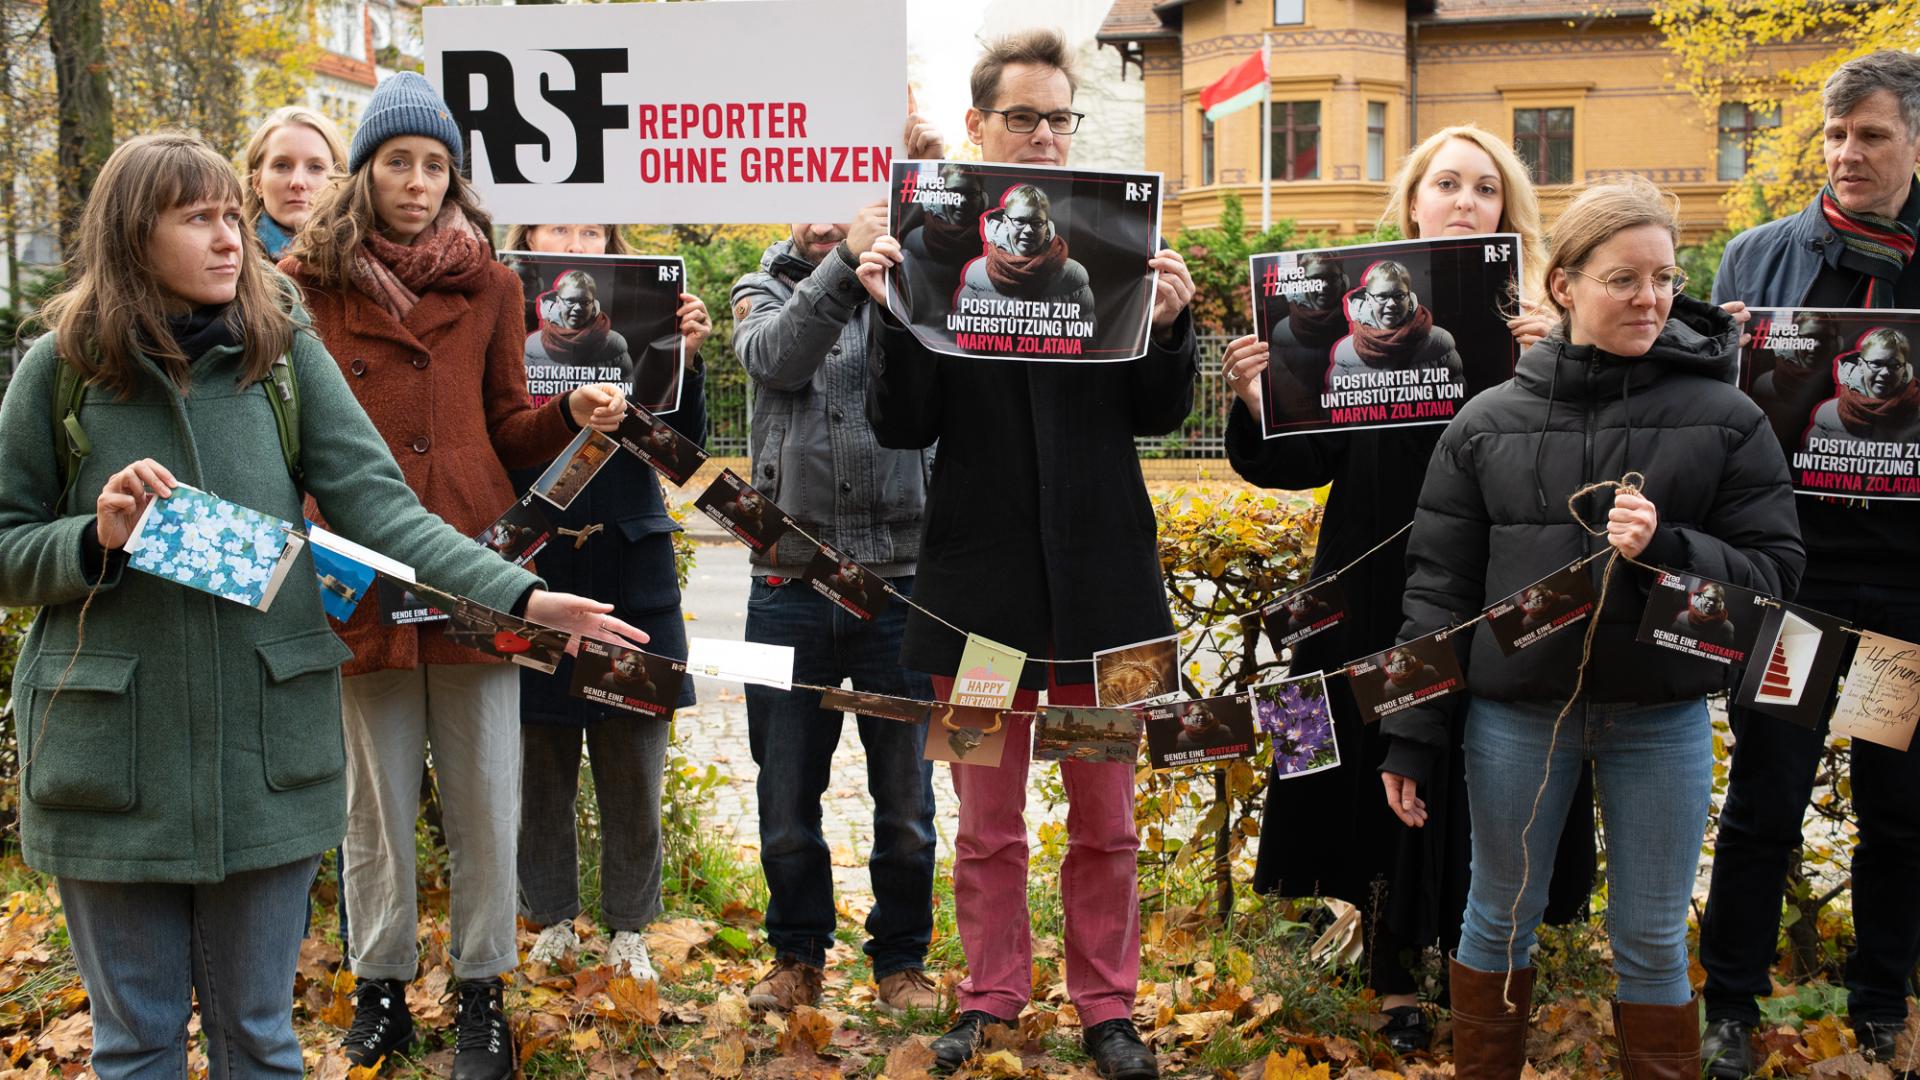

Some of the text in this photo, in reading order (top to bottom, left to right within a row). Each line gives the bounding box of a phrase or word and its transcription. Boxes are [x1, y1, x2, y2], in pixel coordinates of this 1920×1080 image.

[442, 48, 629, 184] RSF
[639, 102, 807, 140] REPORTER
[640, 146, 893, 184] OHNE GRENZEN
[911, 189, 961, 206] Zolatava
[1125, 182, 1152, 201] RSF
[1484, 243, 1511, 263] RSF
[658, 265, 680, 282] RSF
[1275, 278, 1323, 296] Zolatava
[960, 298, 1080, 319] POSTKARTEN ZUR
[946, 314, 1094, 337] UNTERSTÜTZUNG VON
[956, 332, 1082, 354] MARYNA ZOLATAVA
[1764, 335, 1815, 350] Zolatava
[598, 367, 622, 380] ZUR
[1333, 367, 1450, 390] POSTKARTEN ZUR
[1321, 383, 1464, 408] UNTERSTÜTZUNG VON
[1331, 400, 1454, 424] MARYNA ZOLATAVA
[1809, 437, 1920, 459] POSTKARTEN ZU
[1793, 452, 1914, 476] UNTERSTÜTZUNG
[1802, 471, 1920, 493] MARYNA ZOLATA
[1513, 631, 1536, 647] SENDE
[1653, 629, 1745, 660] SENDE EINE POSTKARTE
[583, 686, 608, 698] SENDE
[608, 692, 624, 703] EINE
[967, 681, 1004, 694] HAPPY
[959, 695, 1004, 708] BIRTHDAY
[1374, 699, 1398, 713] SENDE
[1397, 693, 1415, 704] EINE
[1163, 751, 1188, 762] SENDE
[1188, 749, 1205, 758] EINE
